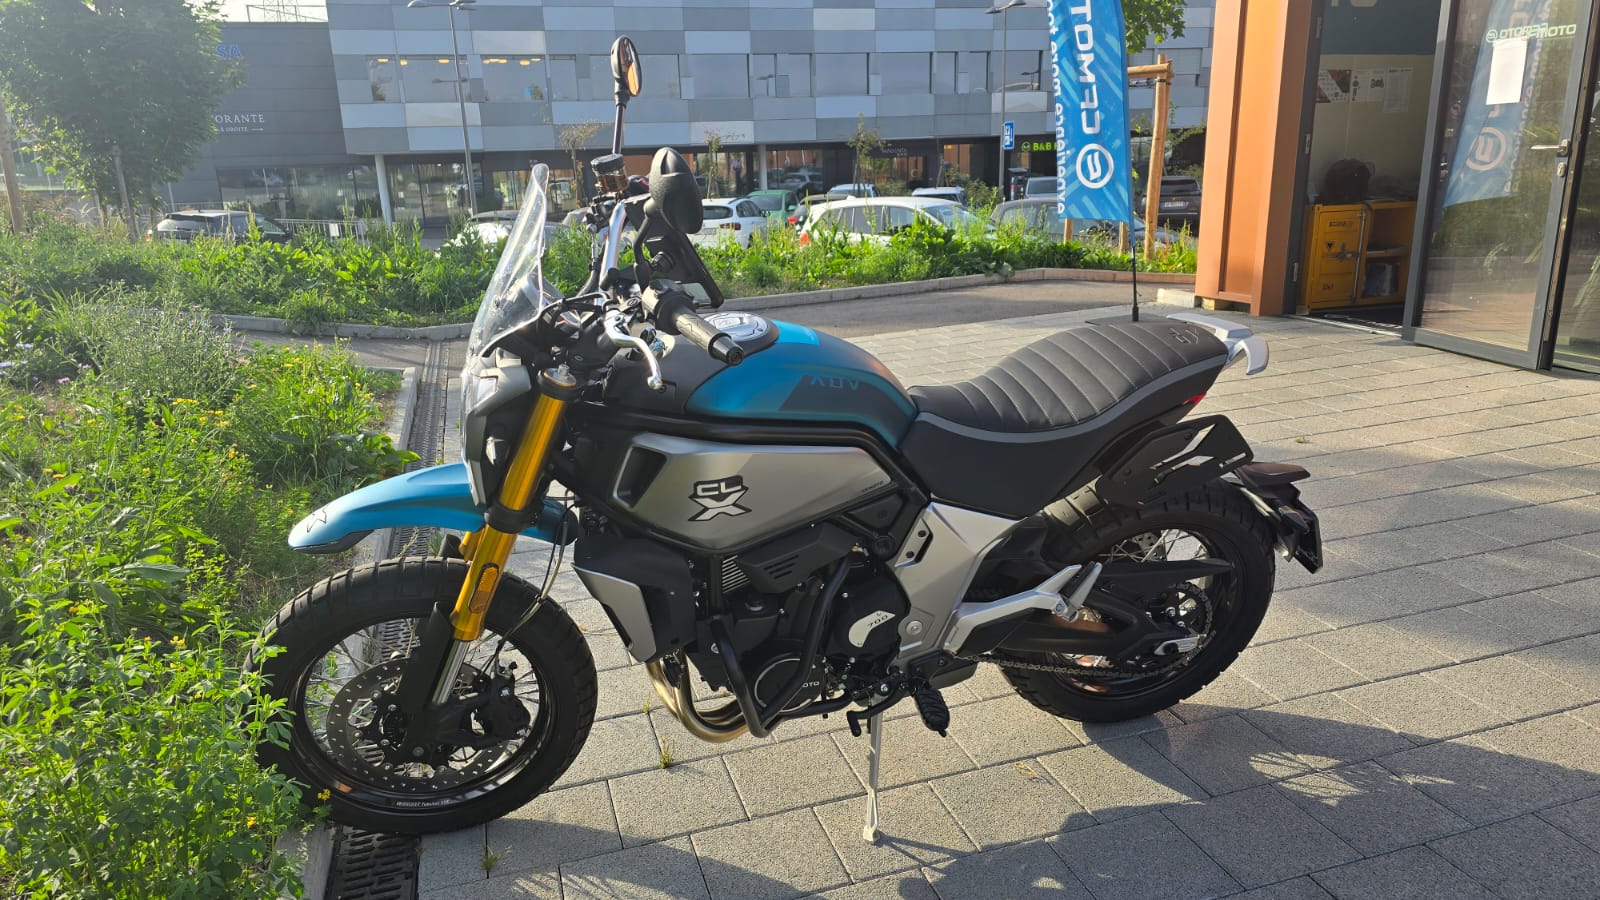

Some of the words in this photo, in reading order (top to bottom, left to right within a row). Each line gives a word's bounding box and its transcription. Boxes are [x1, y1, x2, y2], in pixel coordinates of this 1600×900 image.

[214, 113, 265, 124] ORANTE
[1032, 142, 1052, 151] B&B
[867, 615, 889, 628] 700
